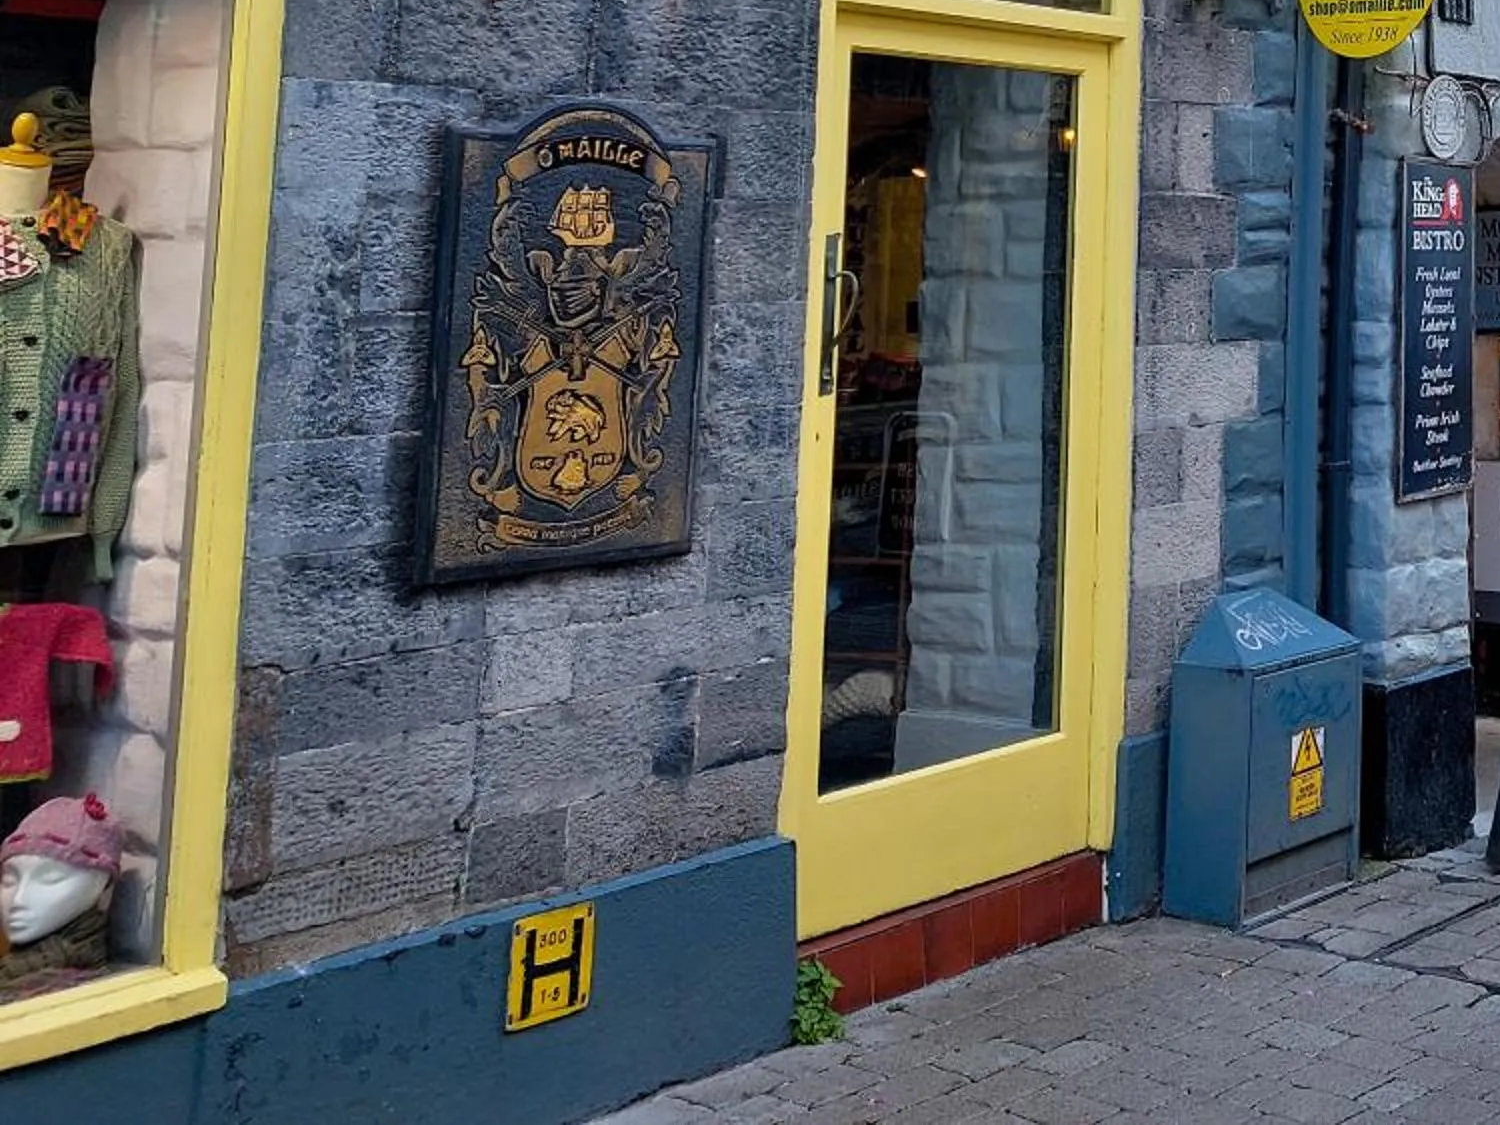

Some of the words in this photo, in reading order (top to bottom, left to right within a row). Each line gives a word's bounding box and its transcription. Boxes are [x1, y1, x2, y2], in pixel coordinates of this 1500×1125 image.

[1367, 26, 1400, 42] 1938
[1413, 203, 1442, 219] HEAD
[1412, 230, 1465, 251] BISTRO
[519, 916, 585, 1022] H
